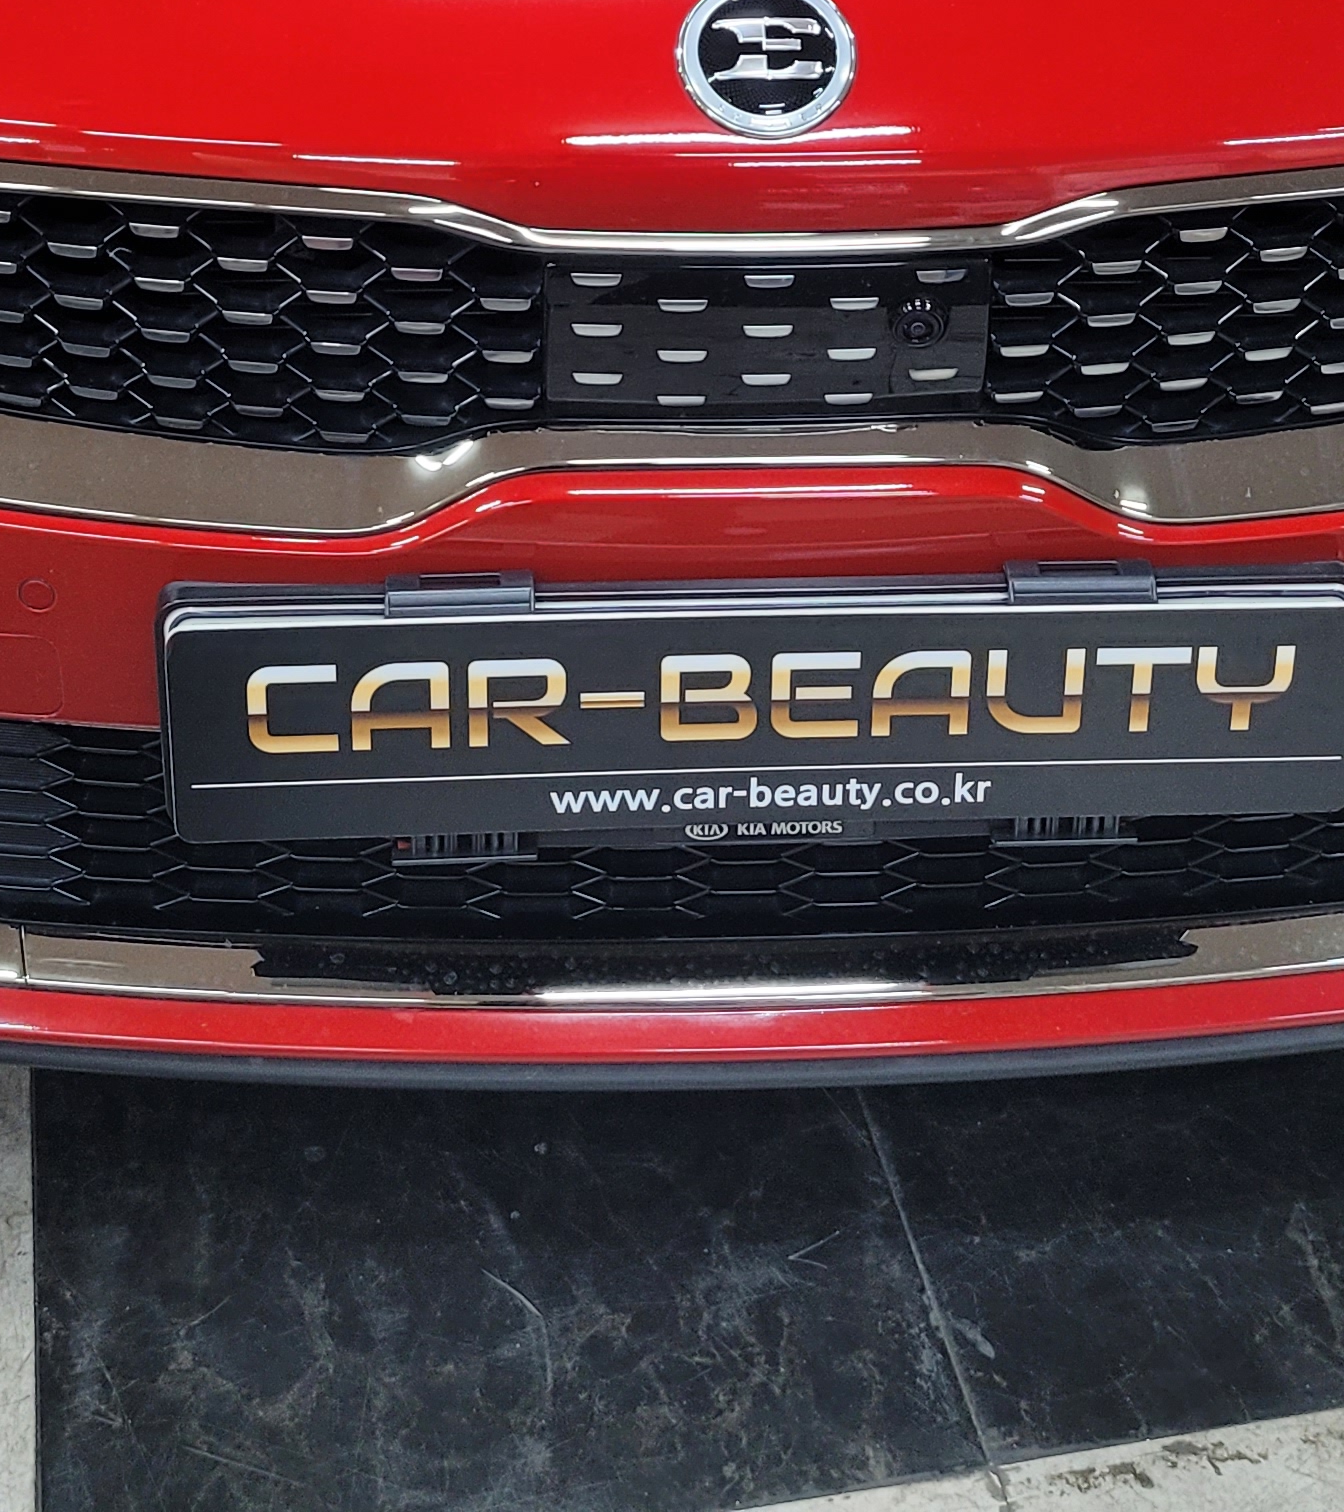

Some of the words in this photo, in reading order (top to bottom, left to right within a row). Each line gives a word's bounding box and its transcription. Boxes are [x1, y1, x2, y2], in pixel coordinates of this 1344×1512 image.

[245, 645, 1297, 755] CAR-BEAUTY
[549, 773, 992, 815] www.car-beauty.co.kr
[737, 823, 767, 836] KIA
[771, 820, 843, 836] MOTORS
